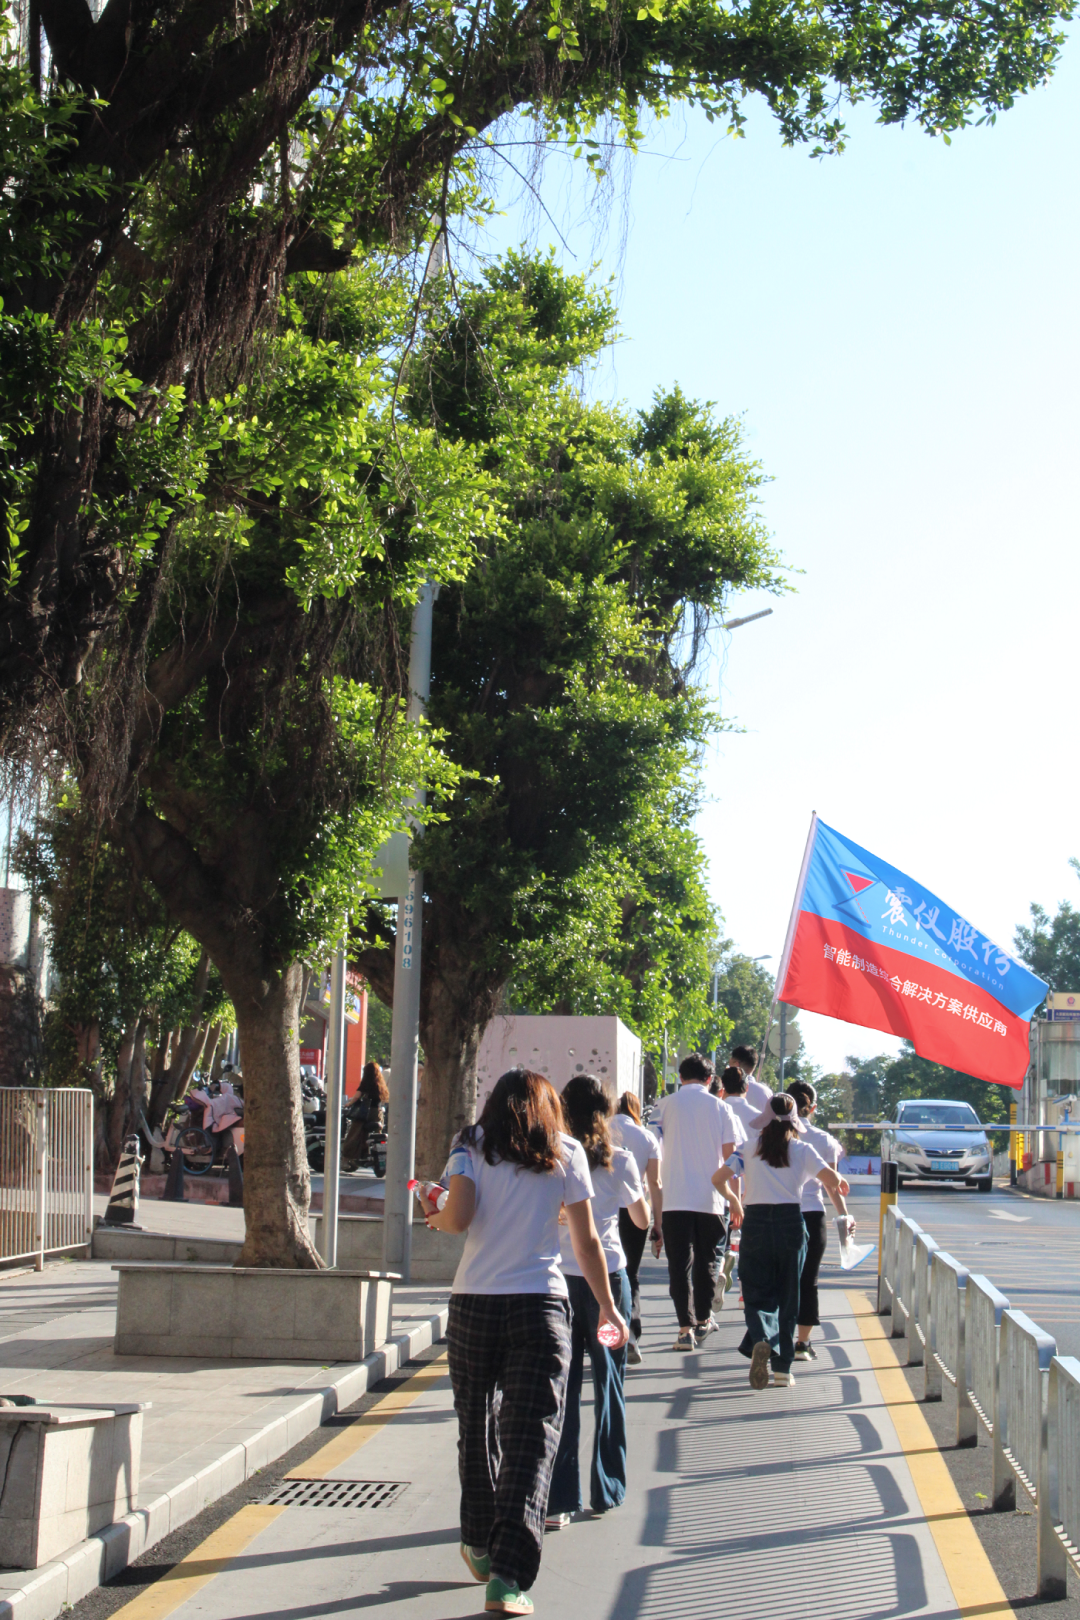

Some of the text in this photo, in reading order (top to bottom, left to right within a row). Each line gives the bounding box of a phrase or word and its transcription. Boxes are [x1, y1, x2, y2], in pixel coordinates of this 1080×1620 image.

[881, 886, 1022, 976] 震仪股份
[882, 925, 1004, 990] Thunder Corporation
